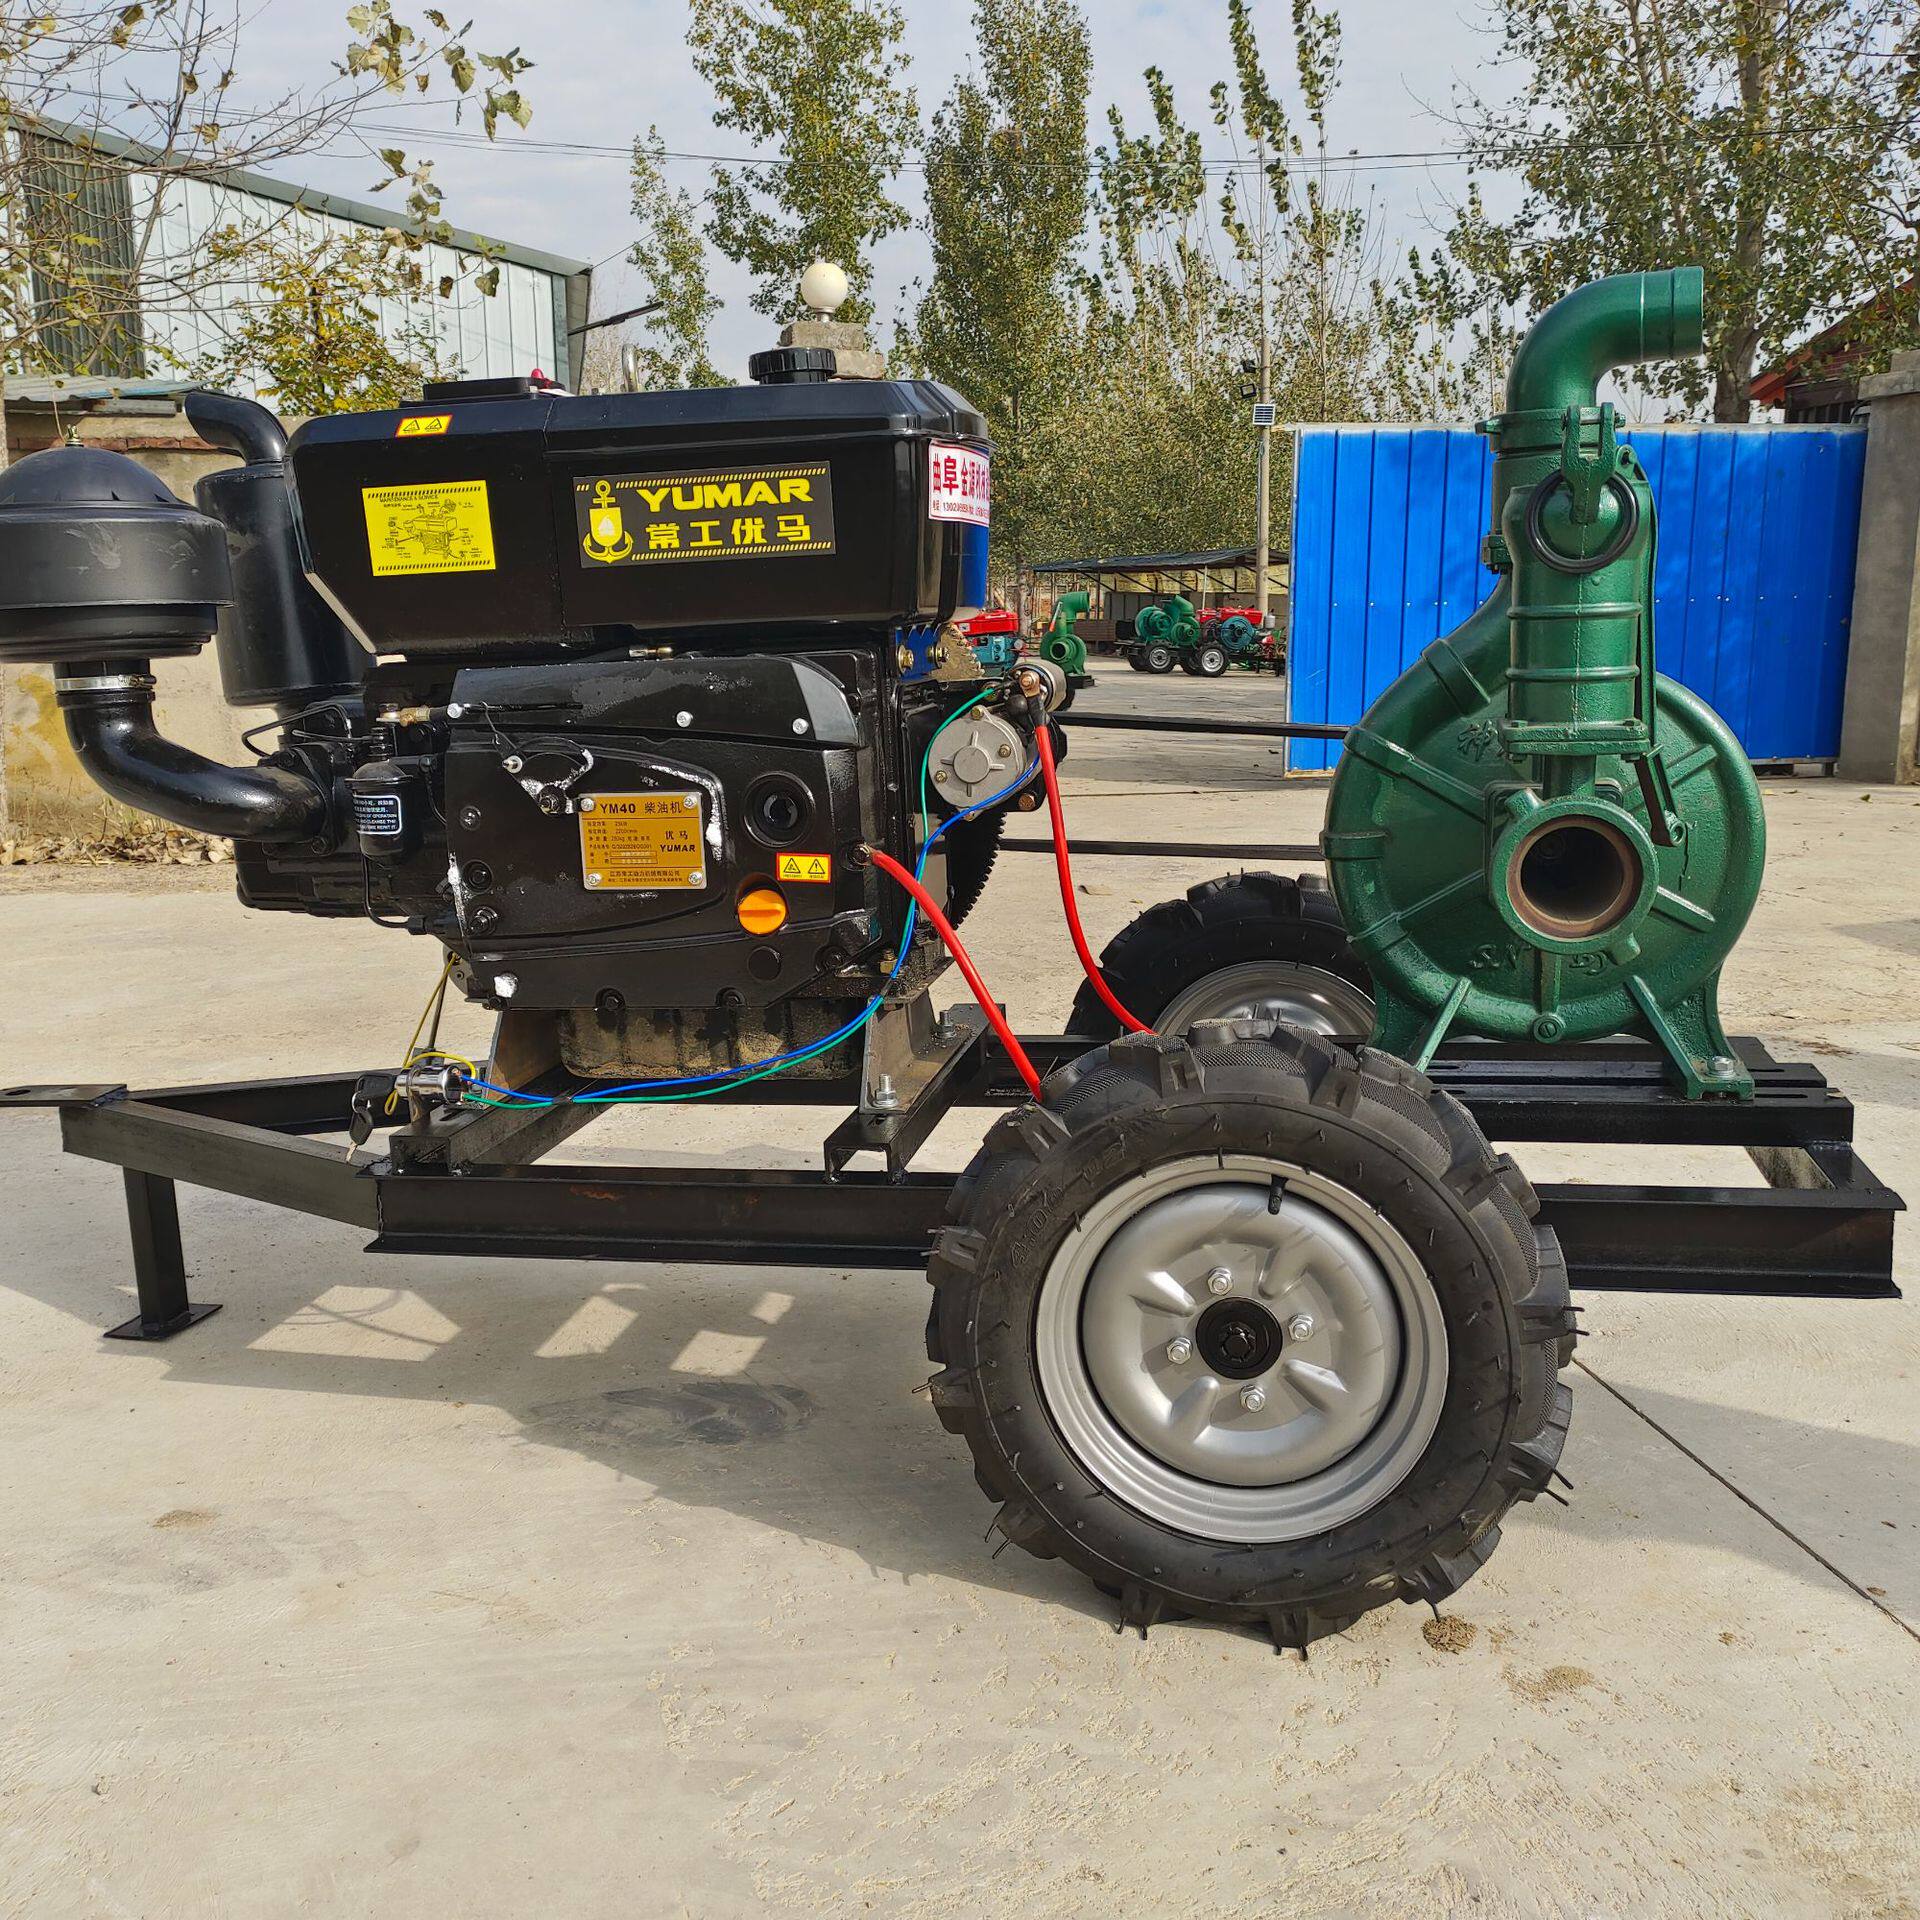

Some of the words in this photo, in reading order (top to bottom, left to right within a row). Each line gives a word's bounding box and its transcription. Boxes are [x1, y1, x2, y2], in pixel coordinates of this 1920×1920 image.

[636, 478, 814, 512] YUMAR
[645, 514, 811, 550] 常工优马
[600, 803, 636, 814] YM40
[644, 801, 682, 814] 柴油机
[660, 844, 696, 852] YUMAR
